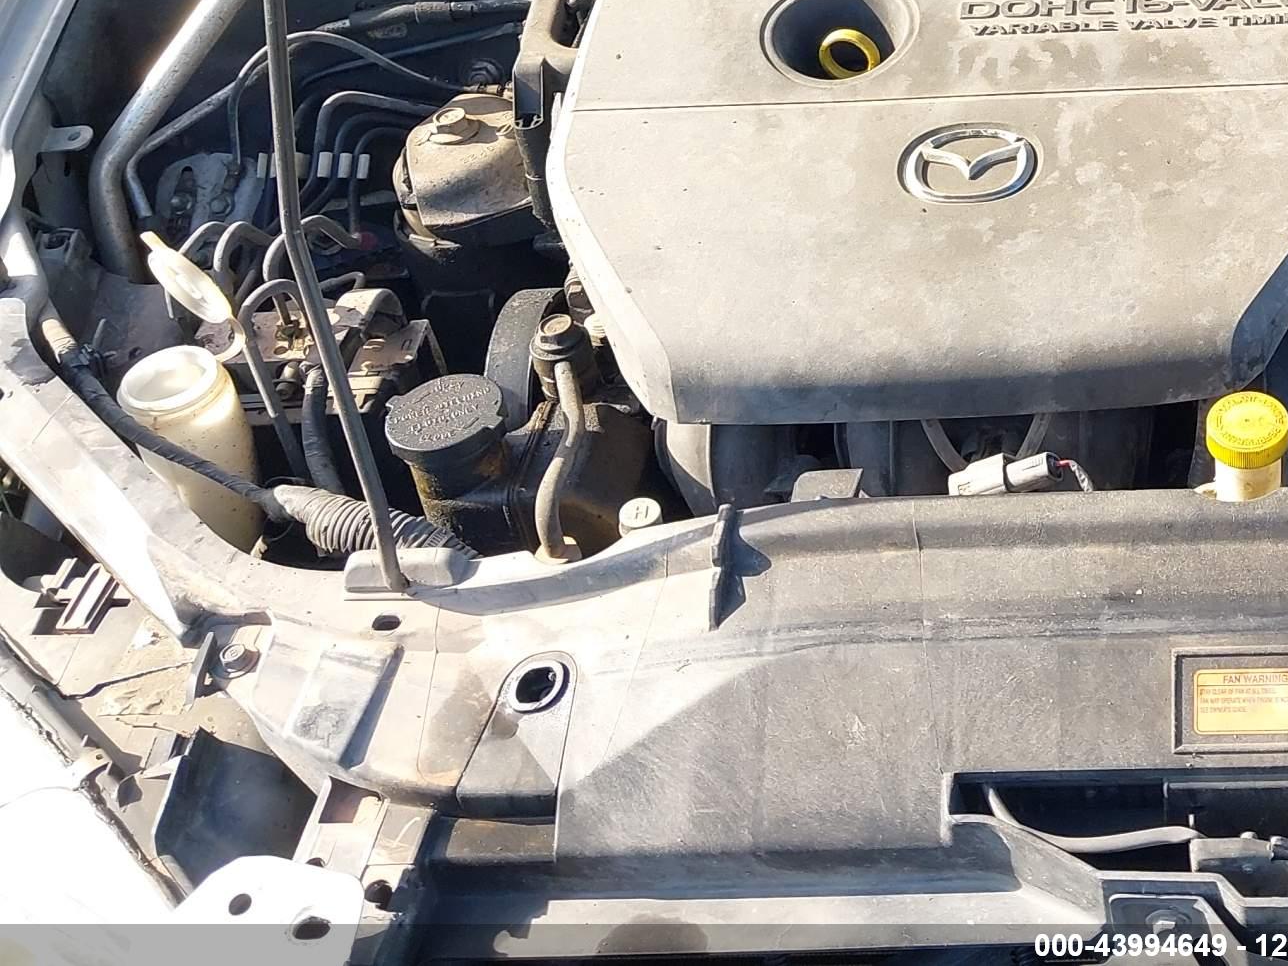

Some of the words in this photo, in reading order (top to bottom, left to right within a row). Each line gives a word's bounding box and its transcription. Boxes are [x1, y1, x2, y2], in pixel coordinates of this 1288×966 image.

[969, 18, 1119, 36] VARIABLE
[1125, 14, 1218, 31] VALVE
[1222, 674, 1241, 684] FAN
[1243, 674, 1288, 684] WARNING
